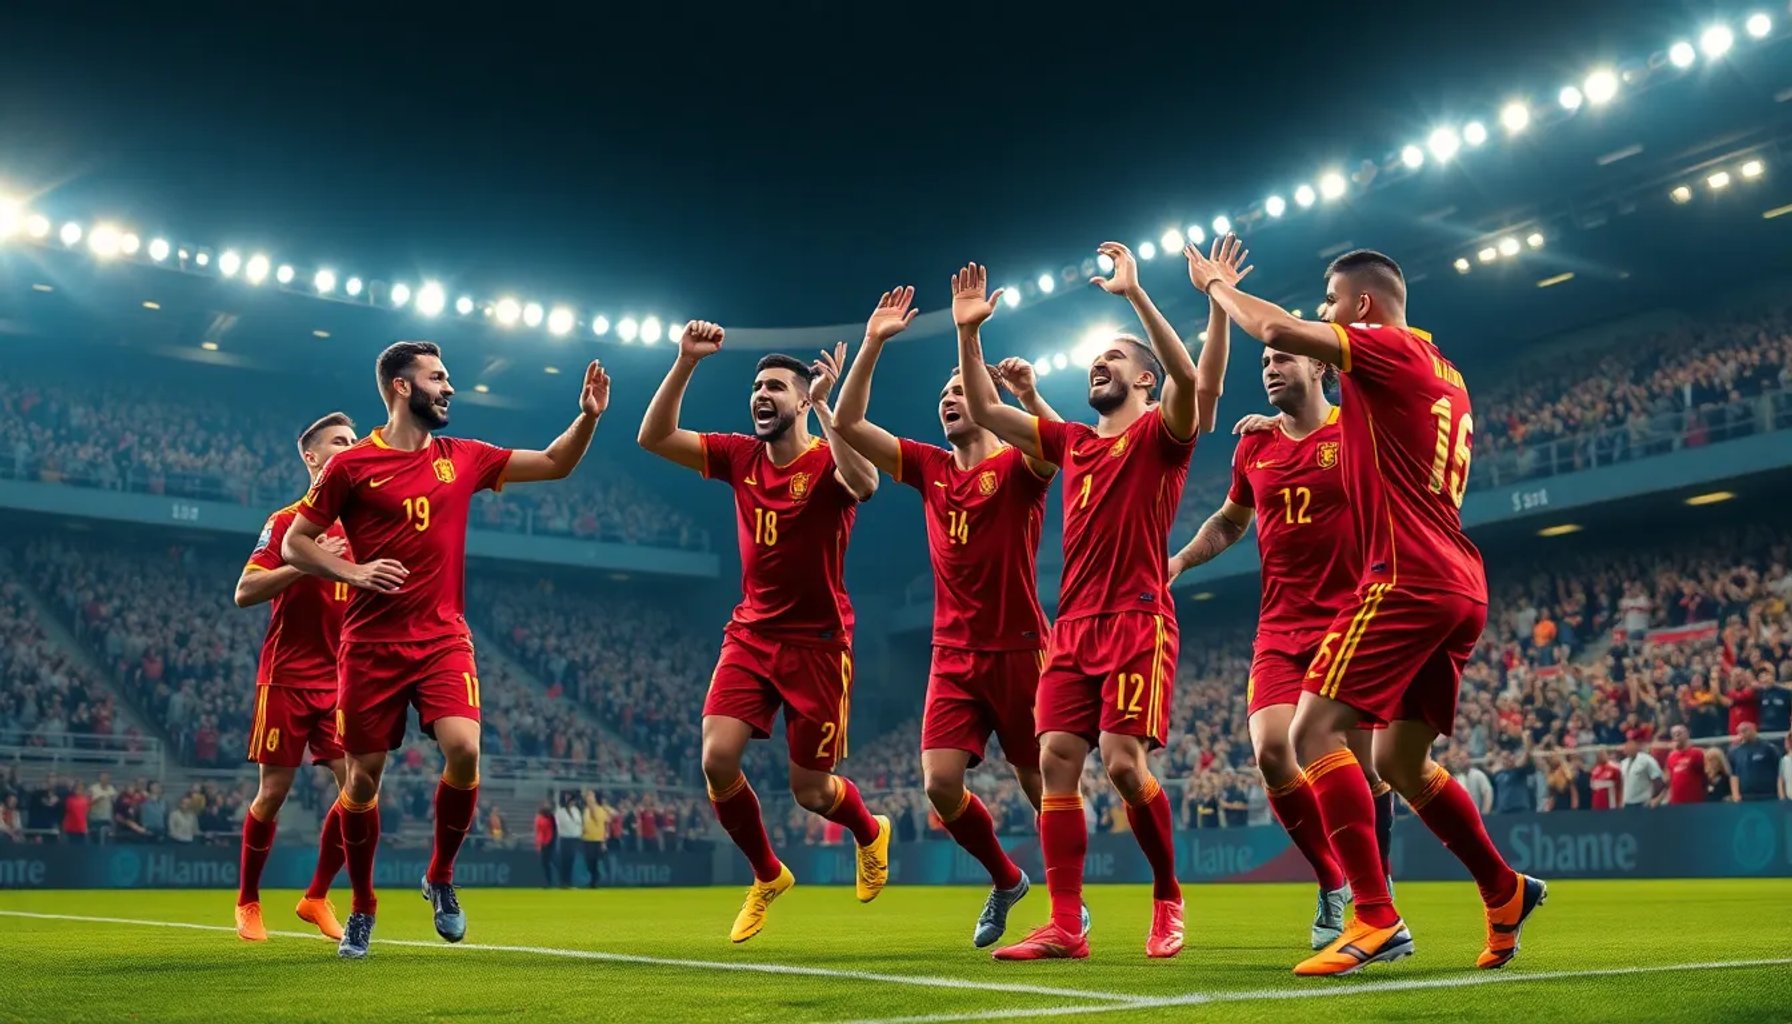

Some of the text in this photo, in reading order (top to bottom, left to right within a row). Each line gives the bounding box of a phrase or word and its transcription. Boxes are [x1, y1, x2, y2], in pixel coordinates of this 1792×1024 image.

[1428, 396, 1474, 510] 16
[402, 496, 430, 532] 19
[1279, 487, 1312, 524] 12
[755, 508, 778, 547] 18
[1117, 672, 1145, 712] 12
[815, 721, 836, 759] 2
